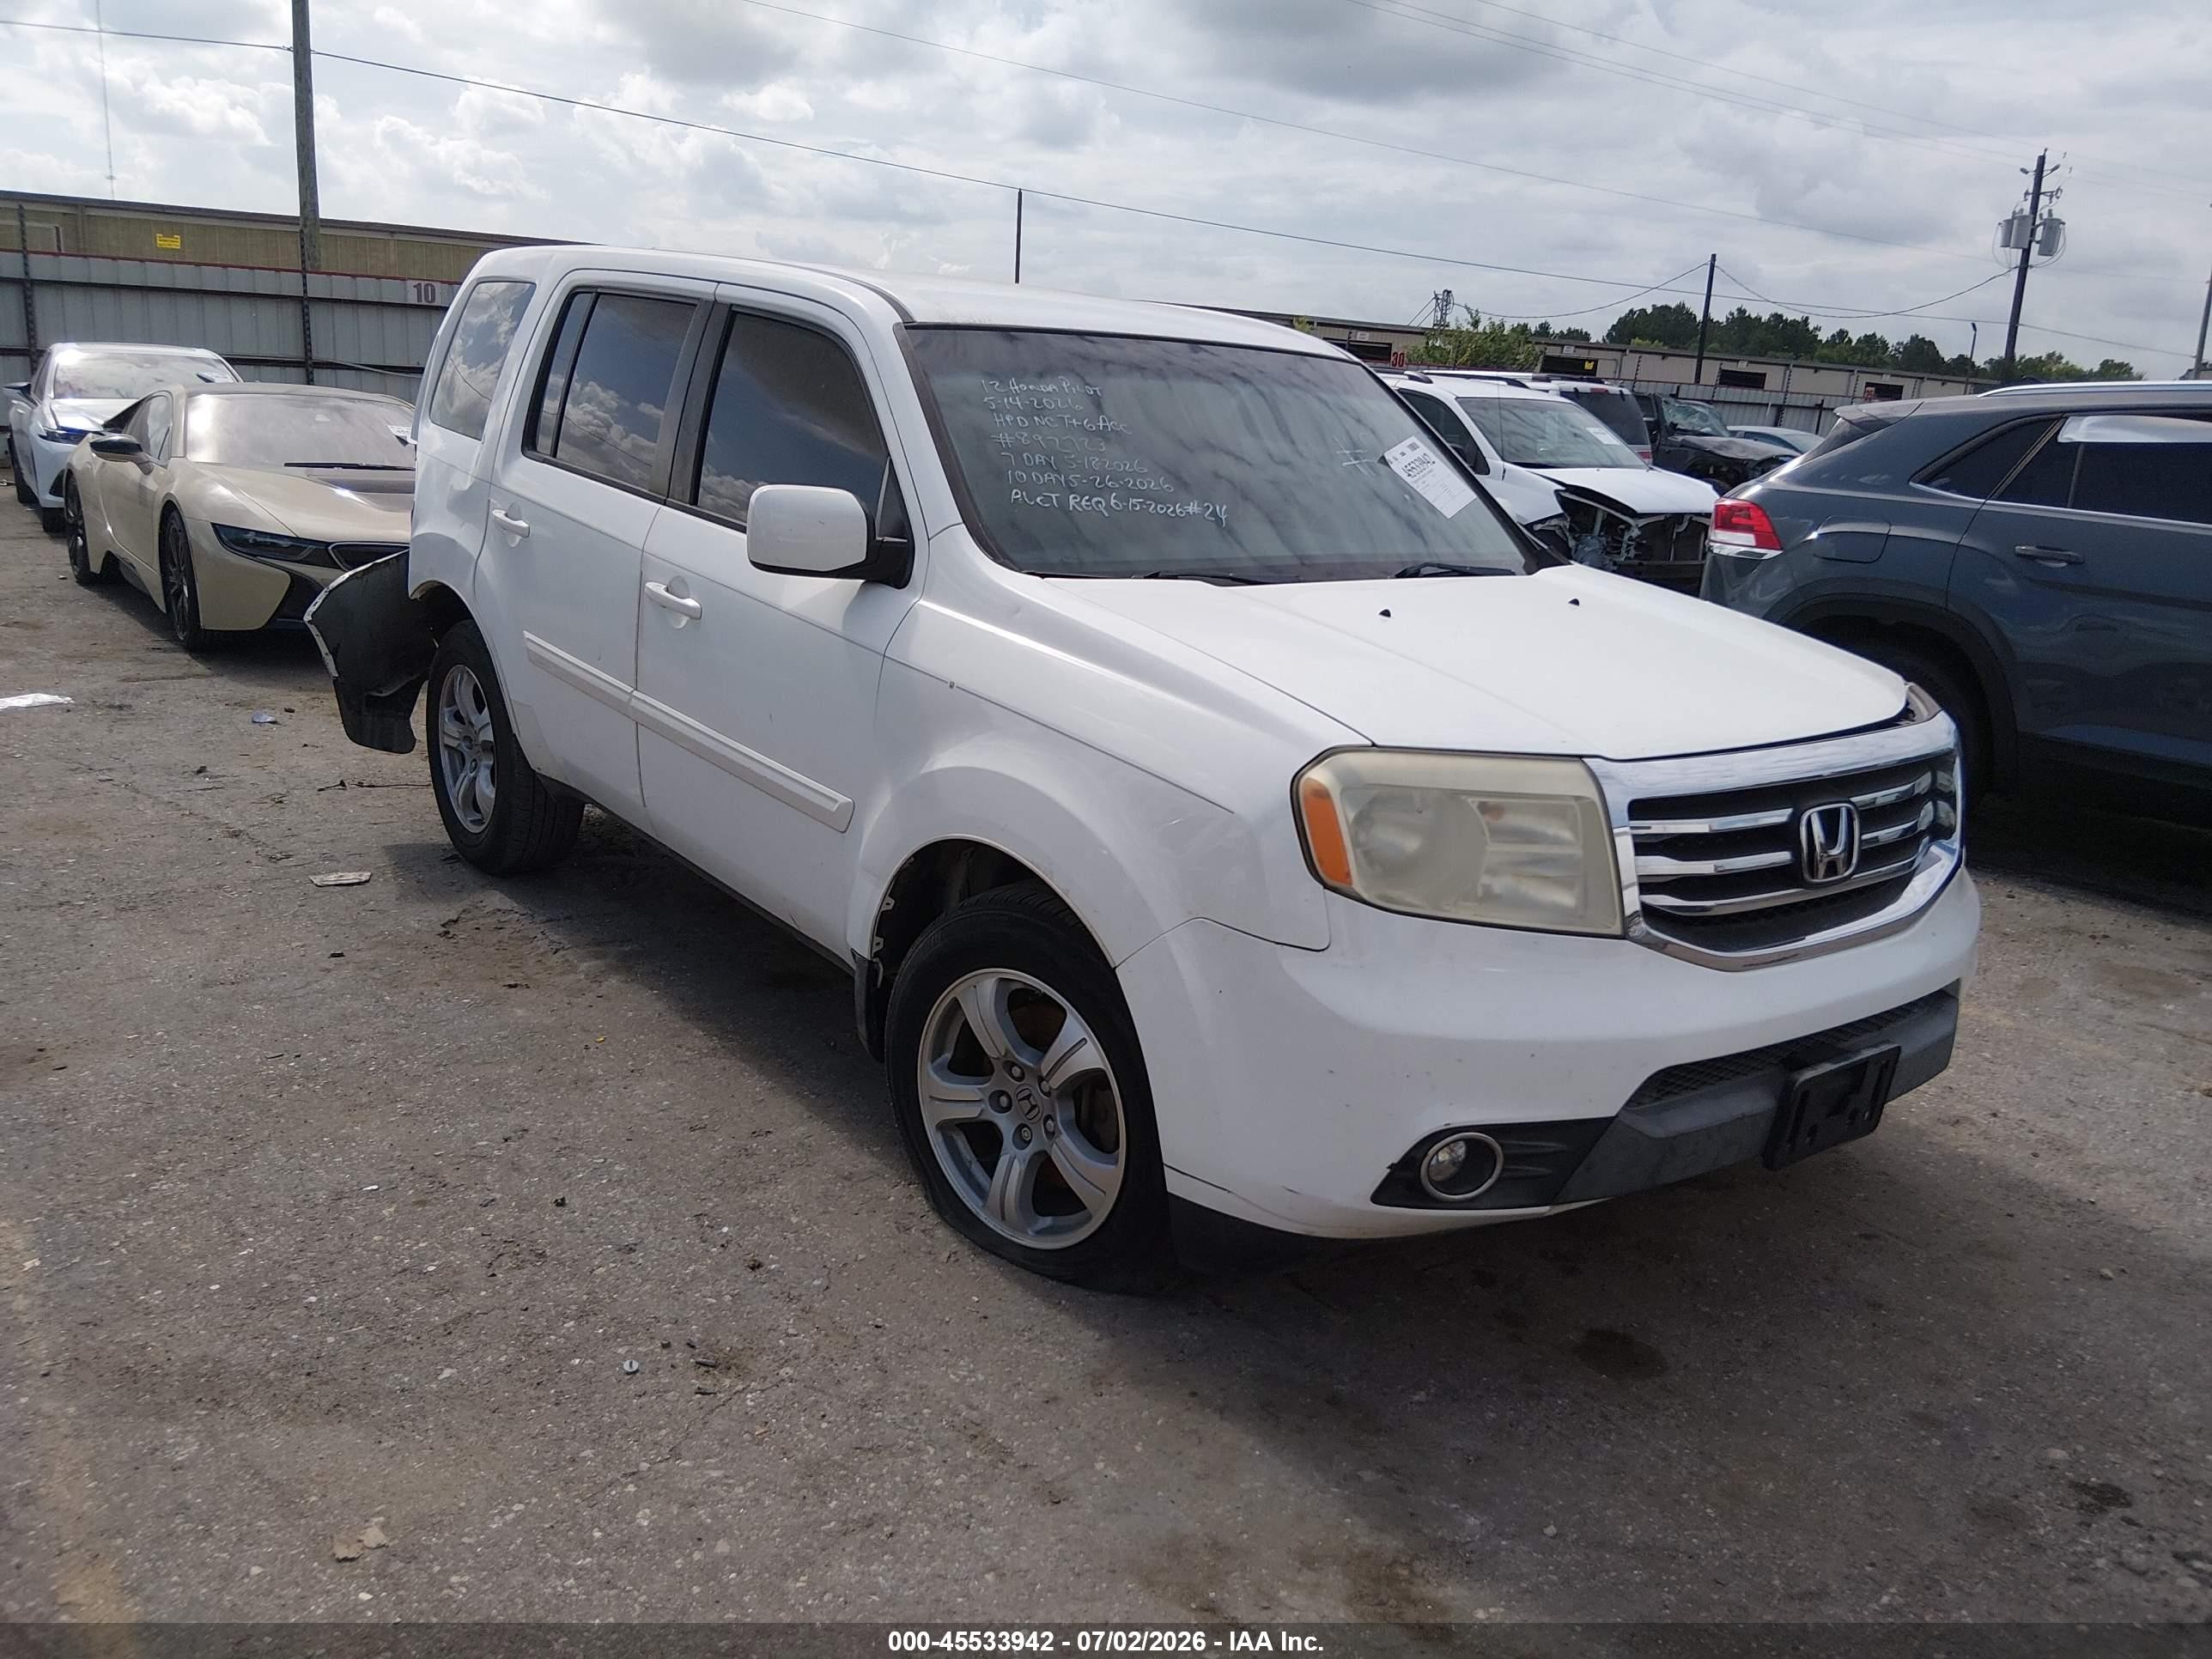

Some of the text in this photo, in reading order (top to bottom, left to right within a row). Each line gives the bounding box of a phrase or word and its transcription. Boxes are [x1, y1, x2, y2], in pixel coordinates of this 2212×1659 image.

[413, 283, 435, 303] 10
[1392, 352, 1405, 367] 30
[993, 412, 1029, 428] HPD
[1022, 453, 1057, 471] DAY
[1008, 470, 1027, 485] 10
[1030, 471, 1066, 488] DAY
[1068, 494, 1110, 517] REQ
